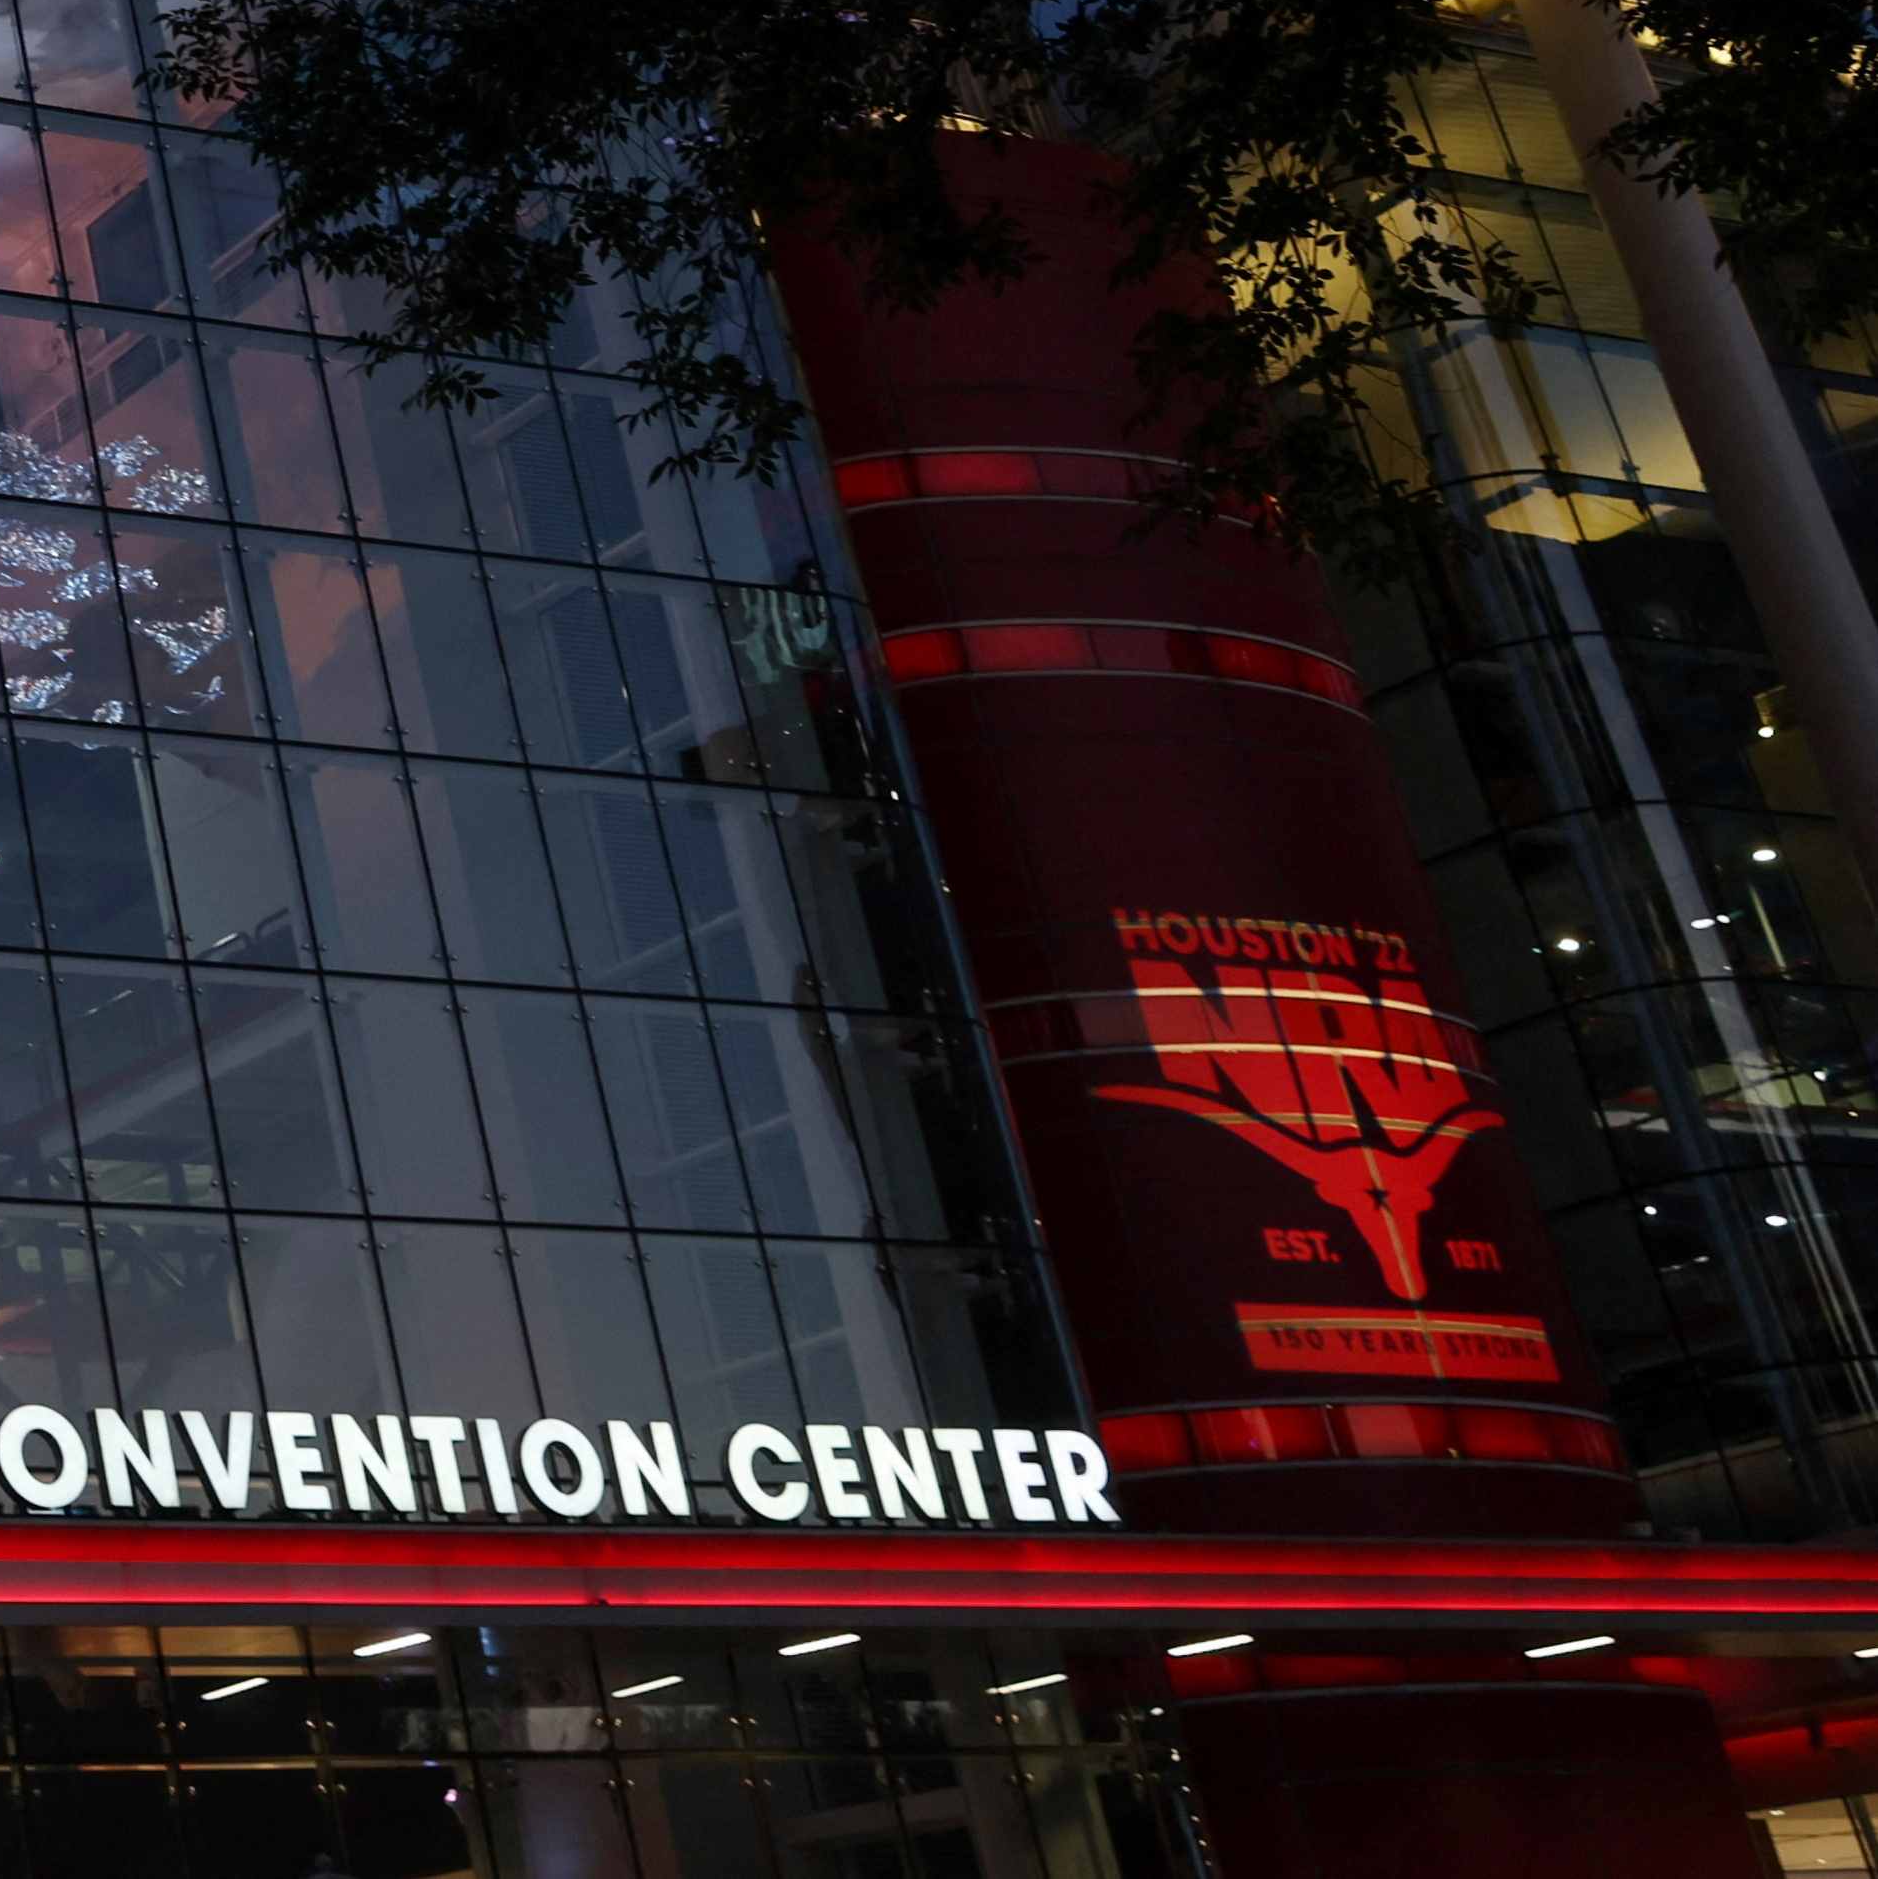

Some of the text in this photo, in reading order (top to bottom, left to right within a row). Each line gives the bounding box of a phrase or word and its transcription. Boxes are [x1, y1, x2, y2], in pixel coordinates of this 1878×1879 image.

[1113, 908, 1359, 968] HOUSTON
[1131, 959, 1472, 1149] NRA
[1263, 1228, 1341, 1264] EST.
[1446, 1239, 1504, 1273] 1871
[1266, 1325, 1541, 1361] 150 YEARS STRONG
[727, 1422, 1121, 1523] CENTER
